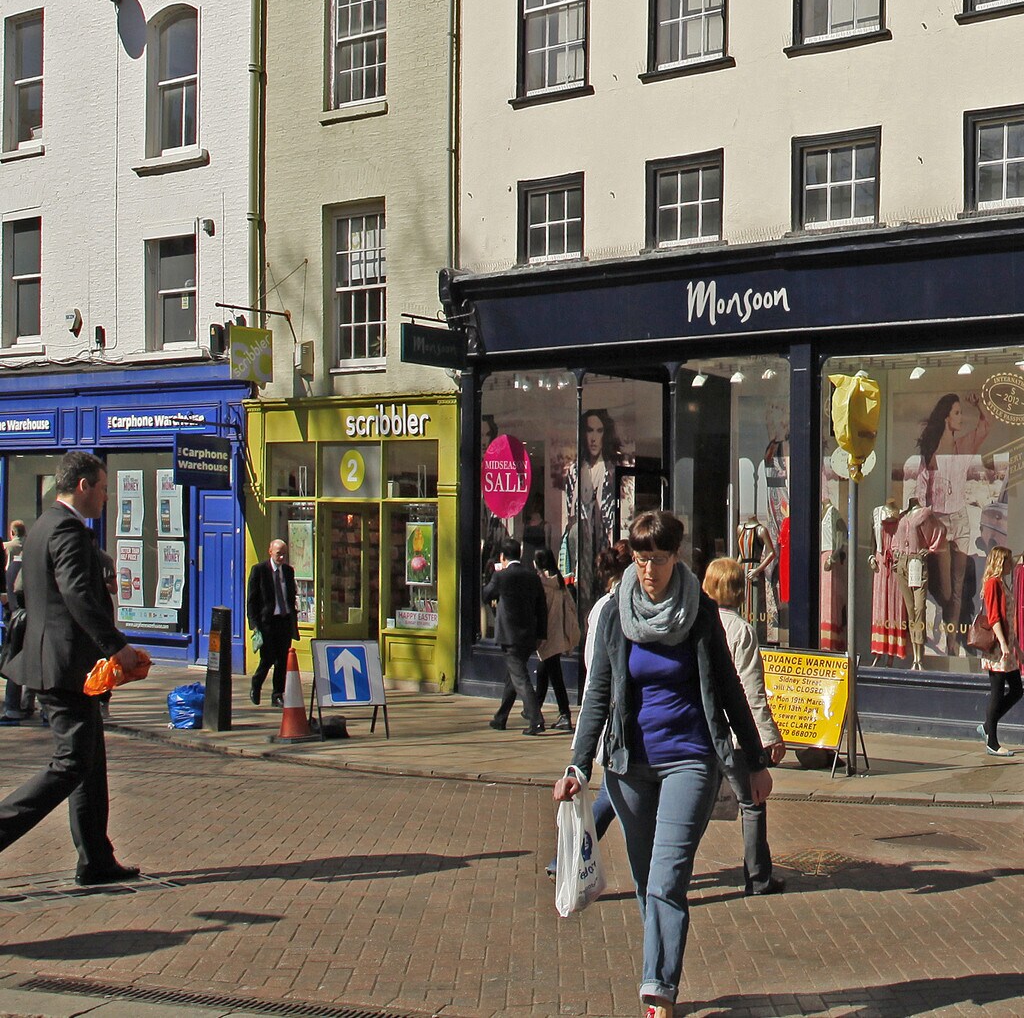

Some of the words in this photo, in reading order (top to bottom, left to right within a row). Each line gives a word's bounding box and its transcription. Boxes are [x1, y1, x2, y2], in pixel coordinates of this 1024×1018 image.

[686, 280, 790, 326] Monsoon
[233, 335, 270, 377] scribbler
[1004, 394, 1020, 406] 2012
[7, 418, 49, 430] Warehouse
[112, 414, 153, 429] Carphone
[154, 412, 205, 426] Warehouse
[345, 403, 430, 436] scribbler
[182, 448, 228, 460] Carphone
[178, 460, 228, 472] Warehouse
[347, 458, 358, 482] 2
[484, 472, 528, 492] SALE
[398, 612, 416, 620] HAPPY
[418, 614, 438, 622] EASTER
[763, 654, 802, 666] ADVANCE
[806, 658, 848, 670] WARNING
[769, 664, 792, 674] ROAD
[796, 667, 836, 678] CLOSURE
[779, 676, 800, 684] Sidney
[796, 686, 824, 694] CLOSED
[806, 698, 824, 706] Marc
[790, 722, 817, 730] CLARET
[792, 730, 818, 738] 668070
